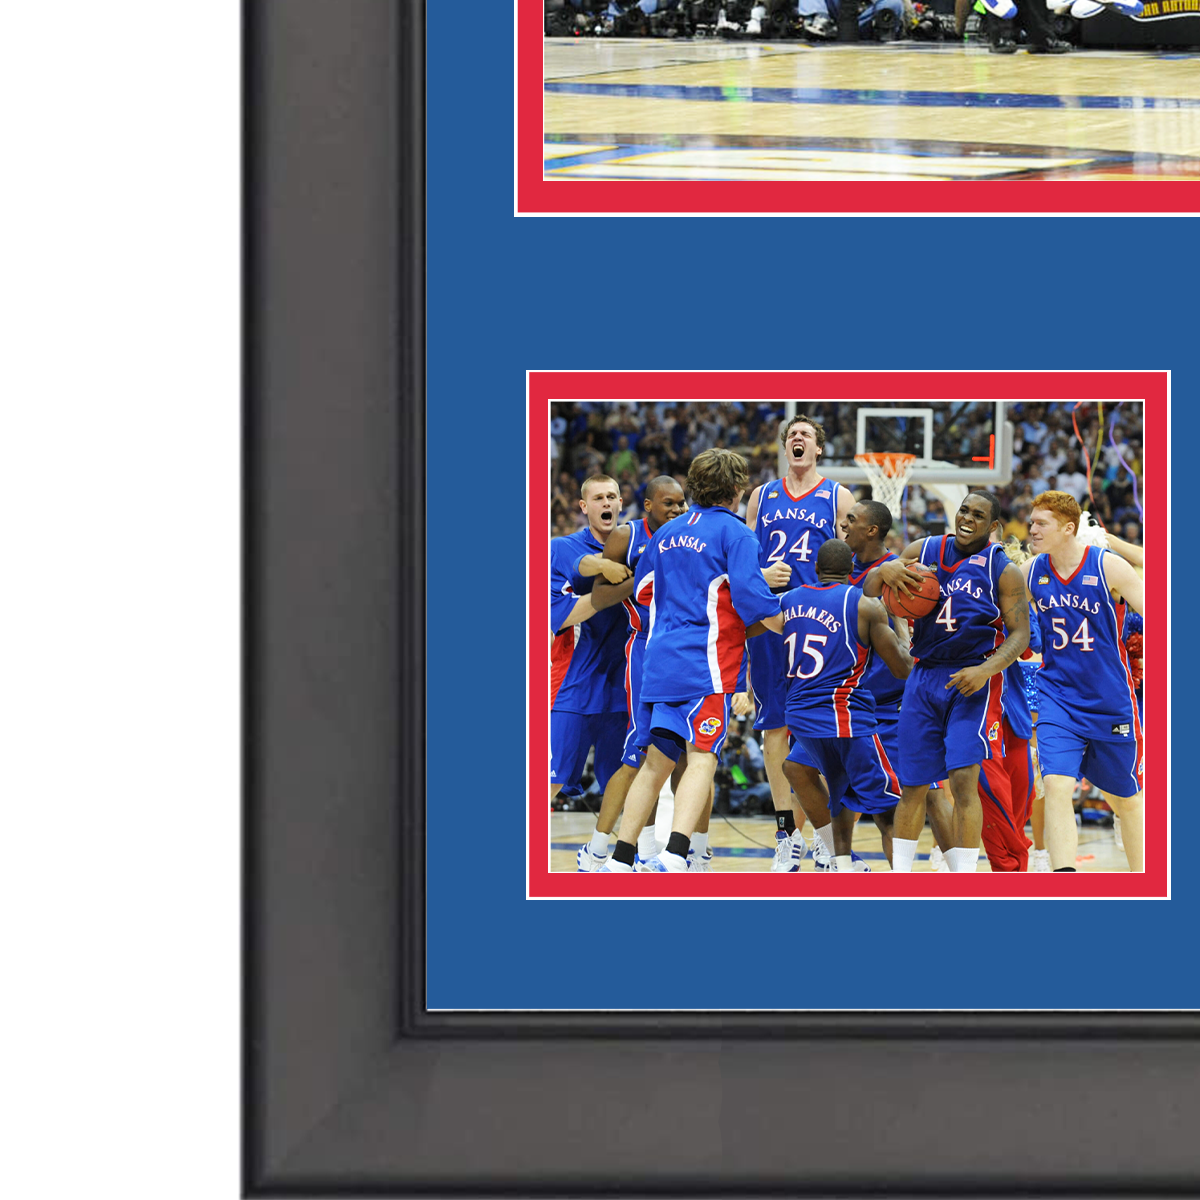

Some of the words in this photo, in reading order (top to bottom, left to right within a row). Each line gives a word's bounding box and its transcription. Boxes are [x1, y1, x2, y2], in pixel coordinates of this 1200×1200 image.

[761, 508, 827, 529] KANSAS
[658, 535, 707, 554] KANSAS
[767, 530, 813, 563] 24
[939, 578, 983, 599] ANSAS
[935, 596, 957, 632] 4
[1037, 593, 1101, 615] KANSAS
[783, 605, 842, 633] HALMERS
[1052, 617, 1094, 652] 54
[783, 632, 828, 679] 15
